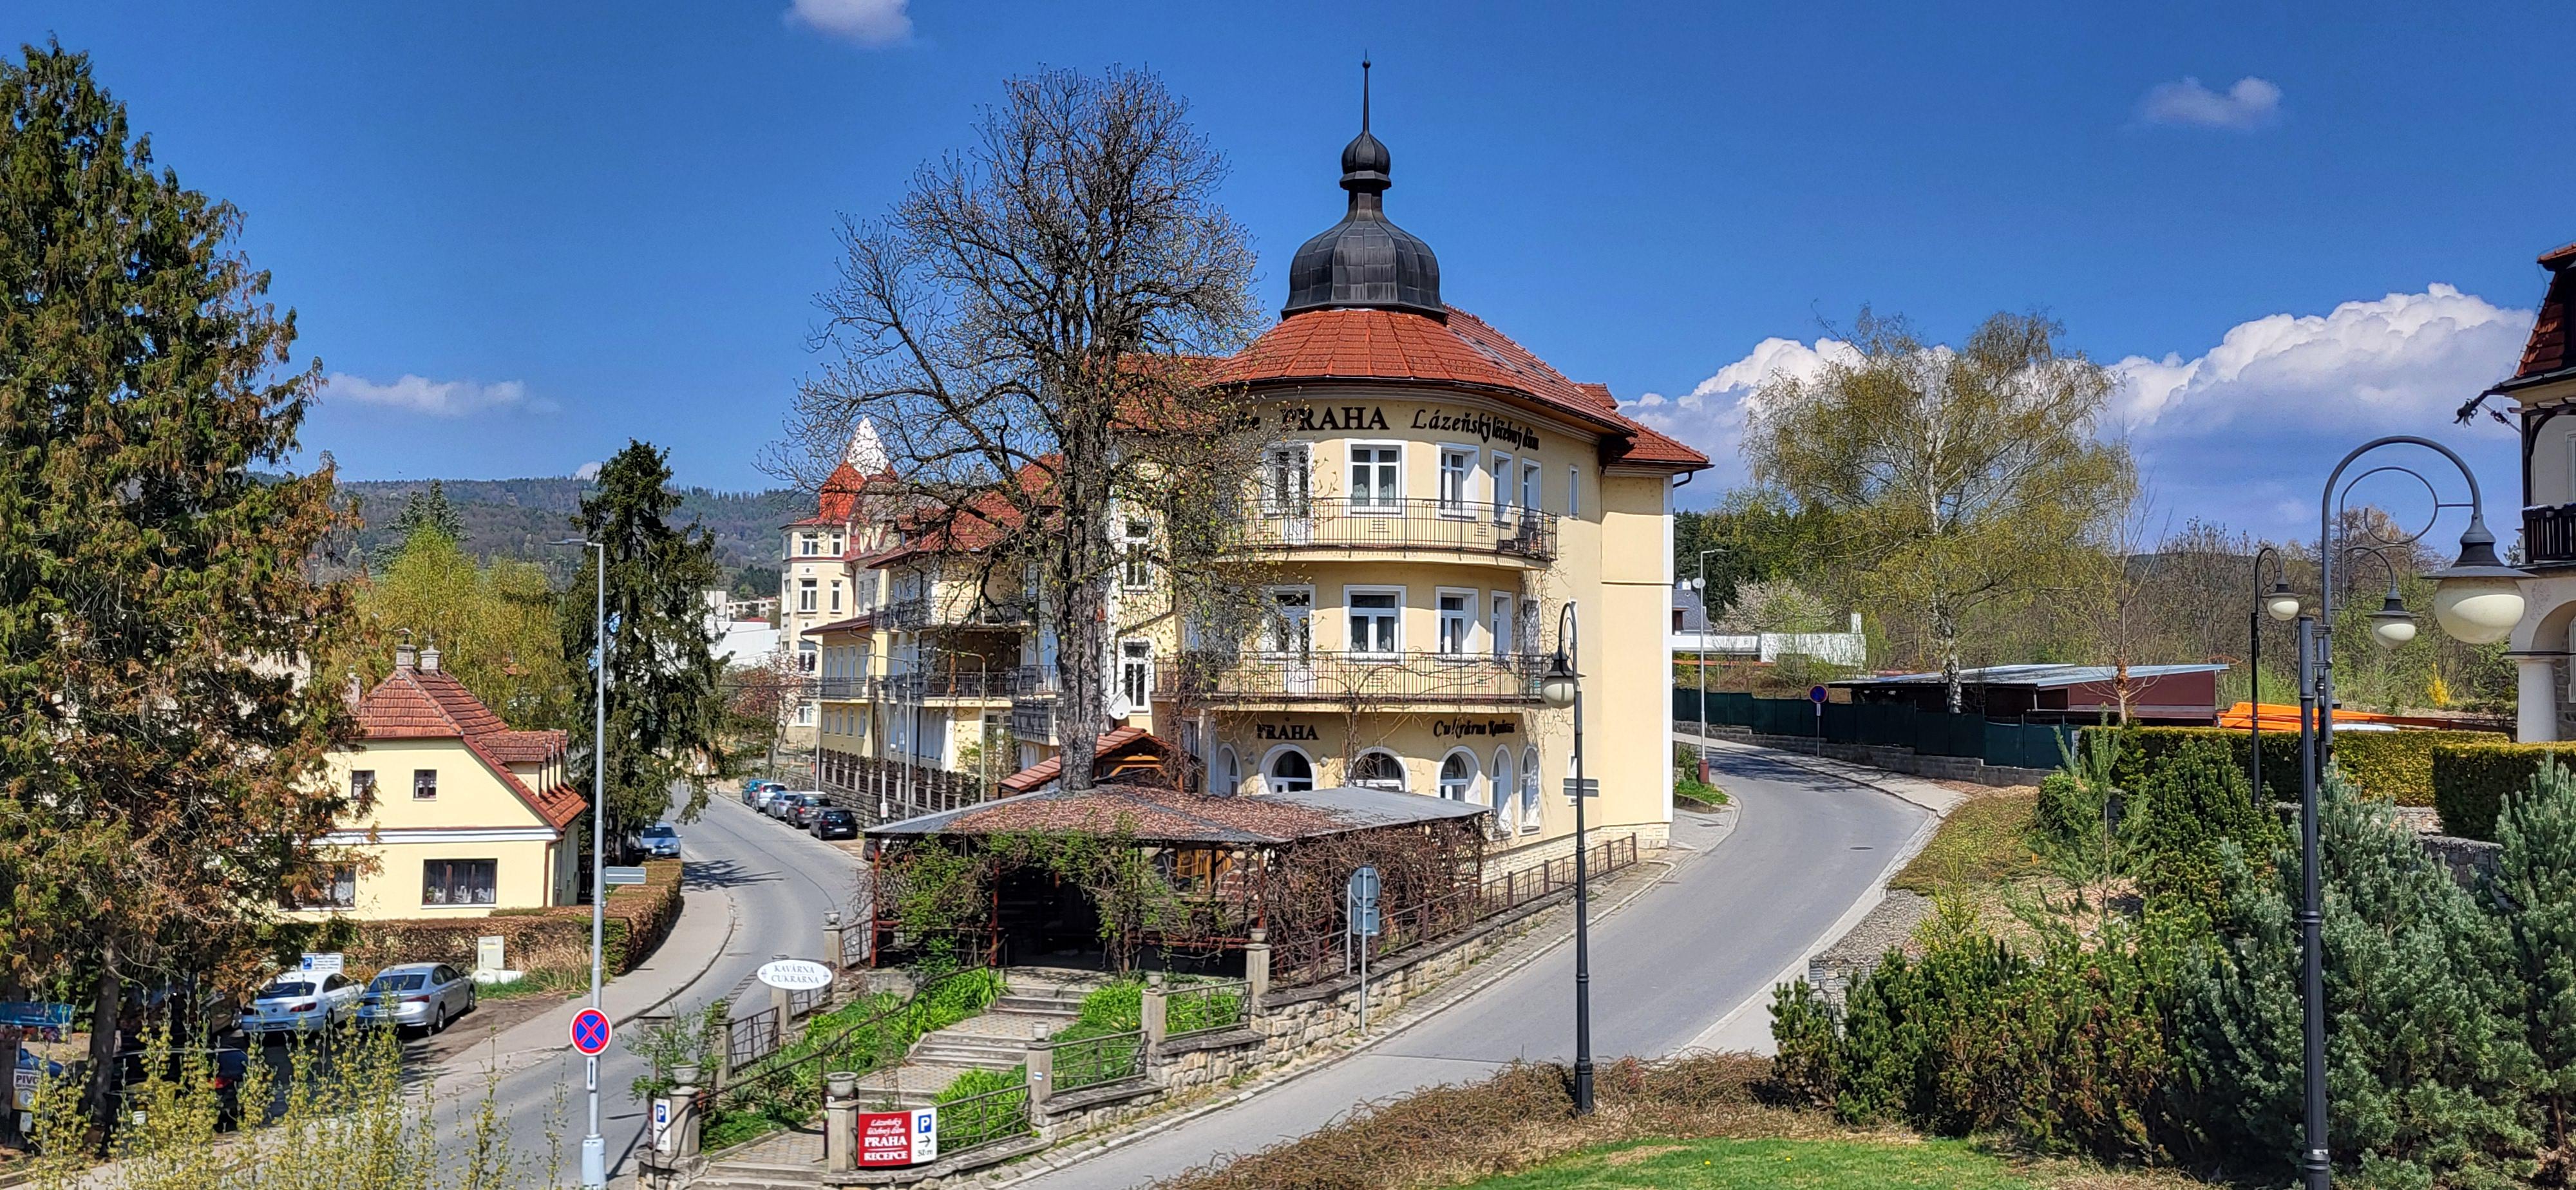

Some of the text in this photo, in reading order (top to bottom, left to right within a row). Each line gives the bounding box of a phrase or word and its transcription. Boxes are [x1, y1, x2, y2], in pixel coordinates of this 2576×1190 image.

[1280, 406, 1390, 431] PRAHA
[1410, 408, 1492, 443] Lázeňský
[920, 1117, 930, 1131] P
[864, 1136, 907, 1147] PRAHA
[864, 1151, 908, 1161] RECEPCE
